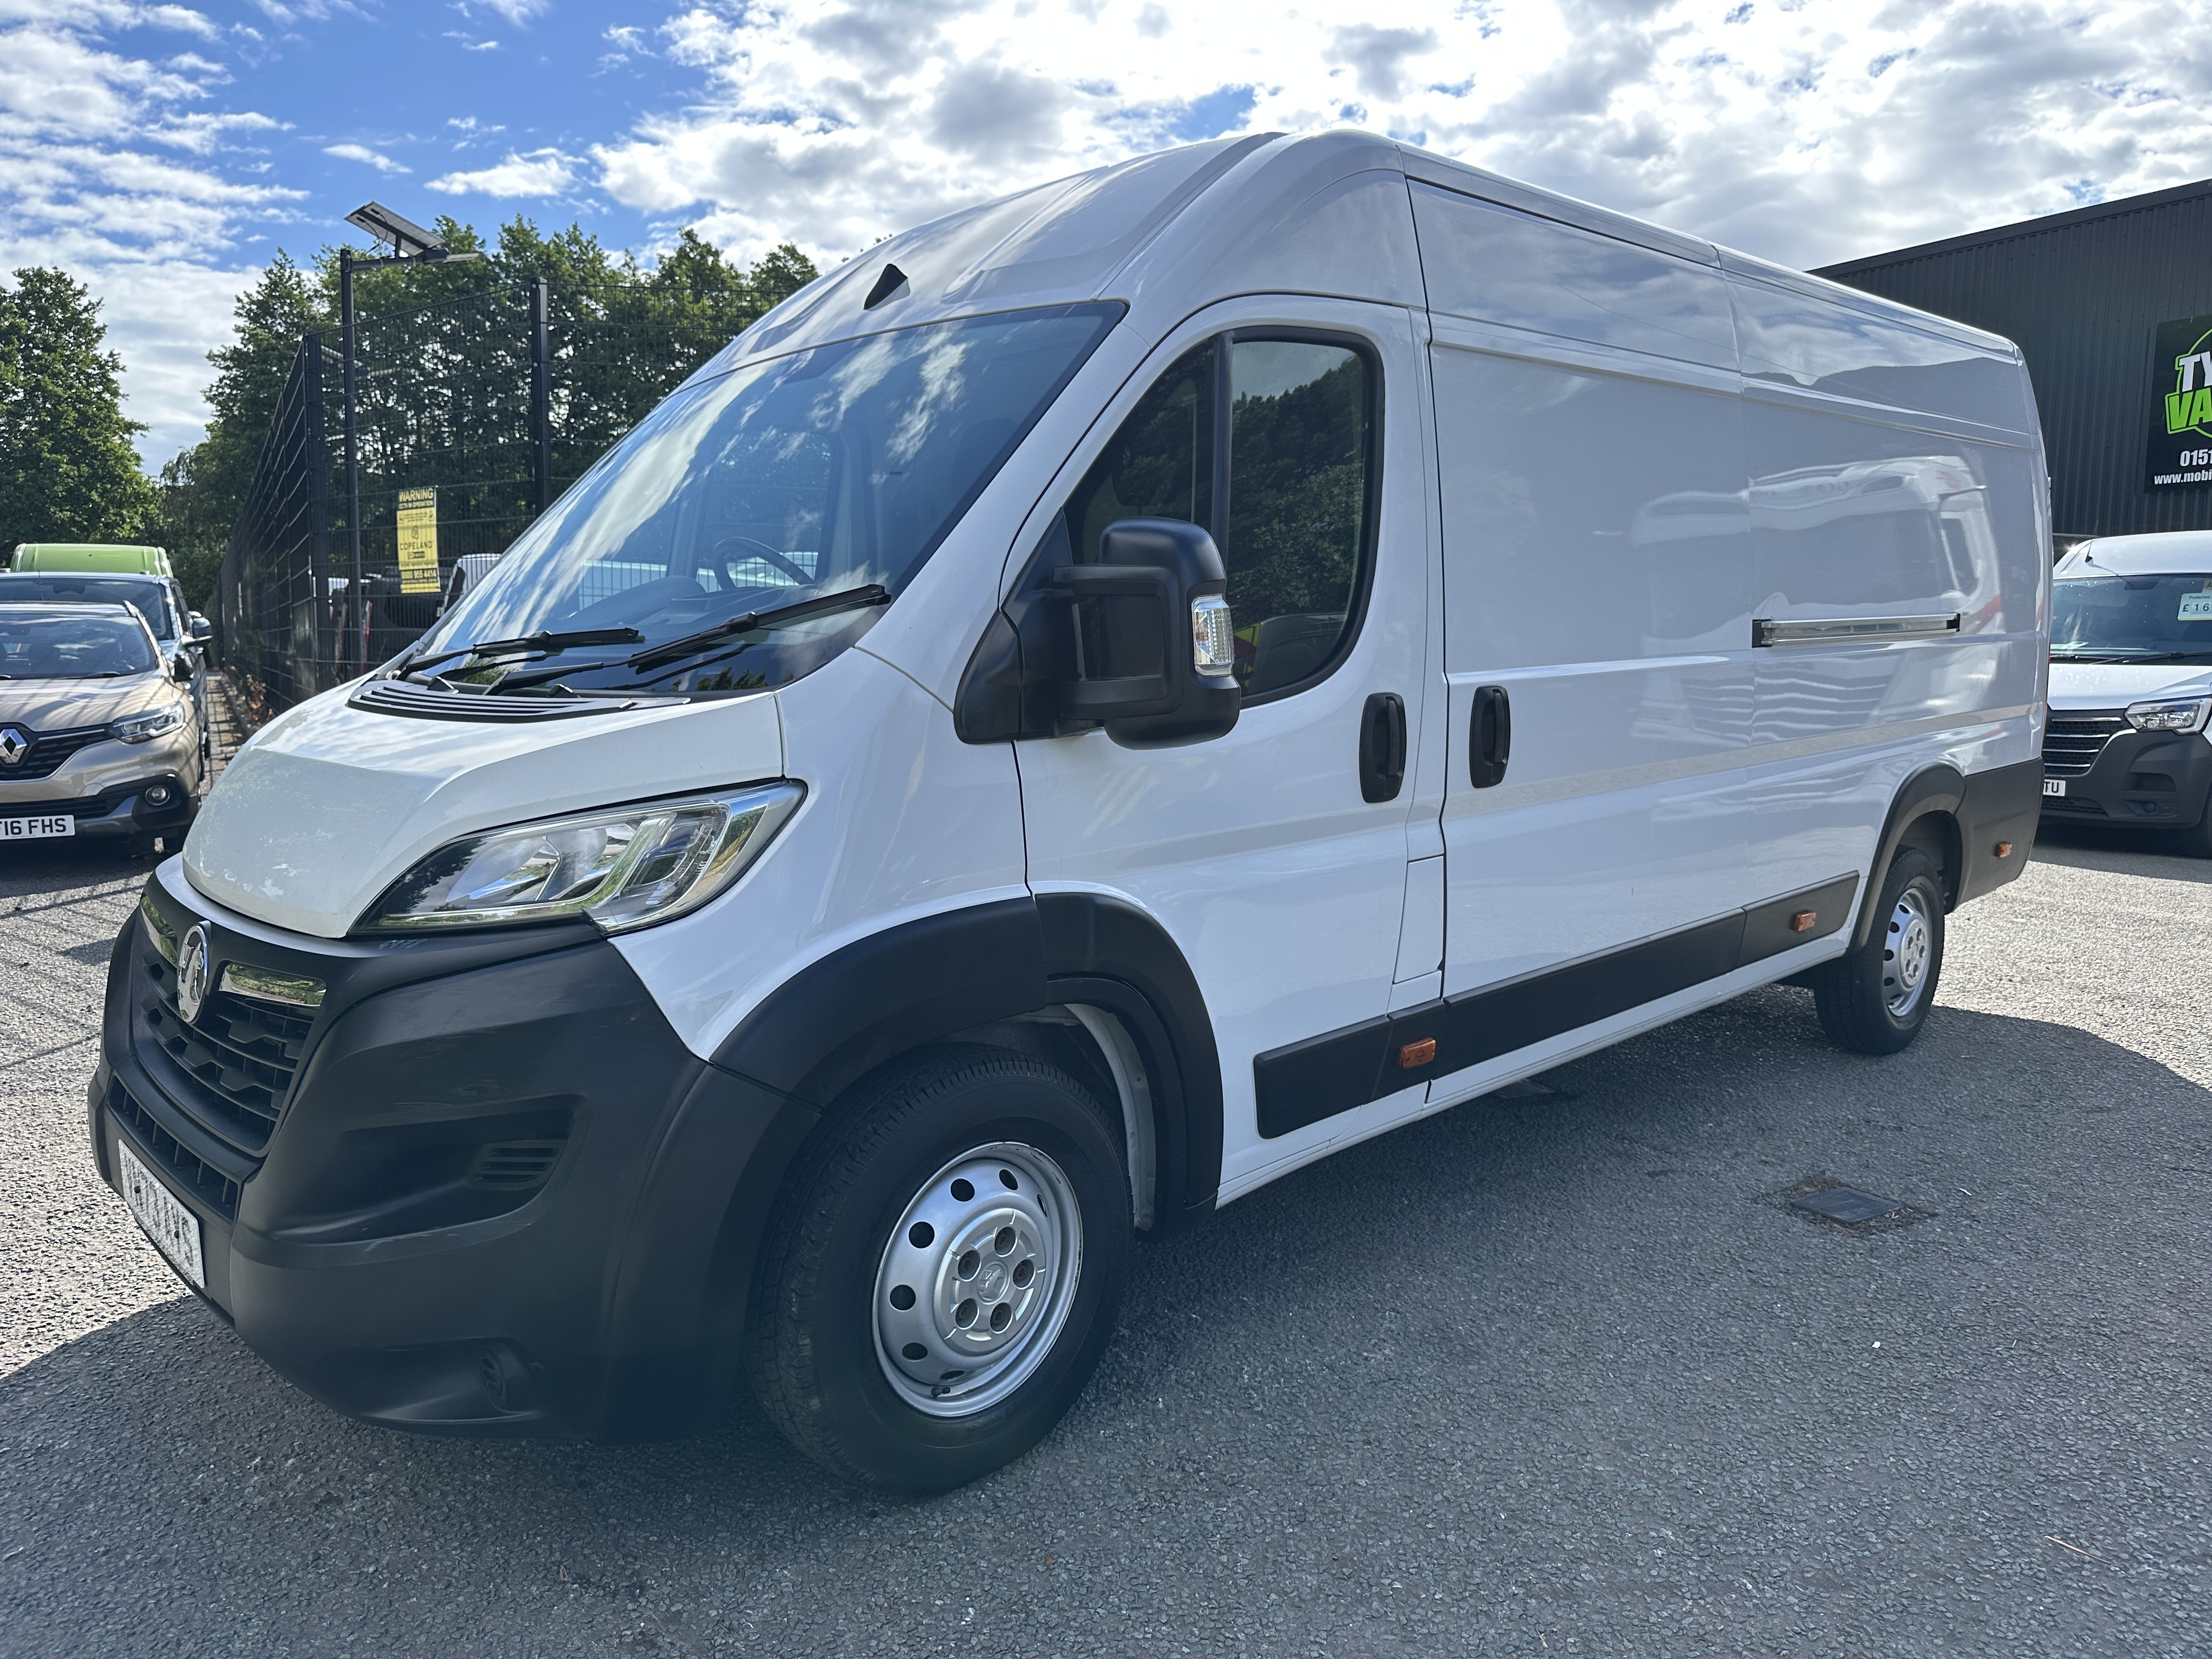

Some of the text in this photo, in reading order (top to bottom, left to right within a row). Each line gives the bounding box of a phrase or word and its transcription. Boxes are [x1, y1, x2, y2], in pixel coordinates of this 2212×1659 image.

[2169, 387, 2212, 430] VA
[398, 487, 433, 503] WARNING
[400, 540, 432, 550] COPELAND
[0, 818, 66, 836] 16 FHS
